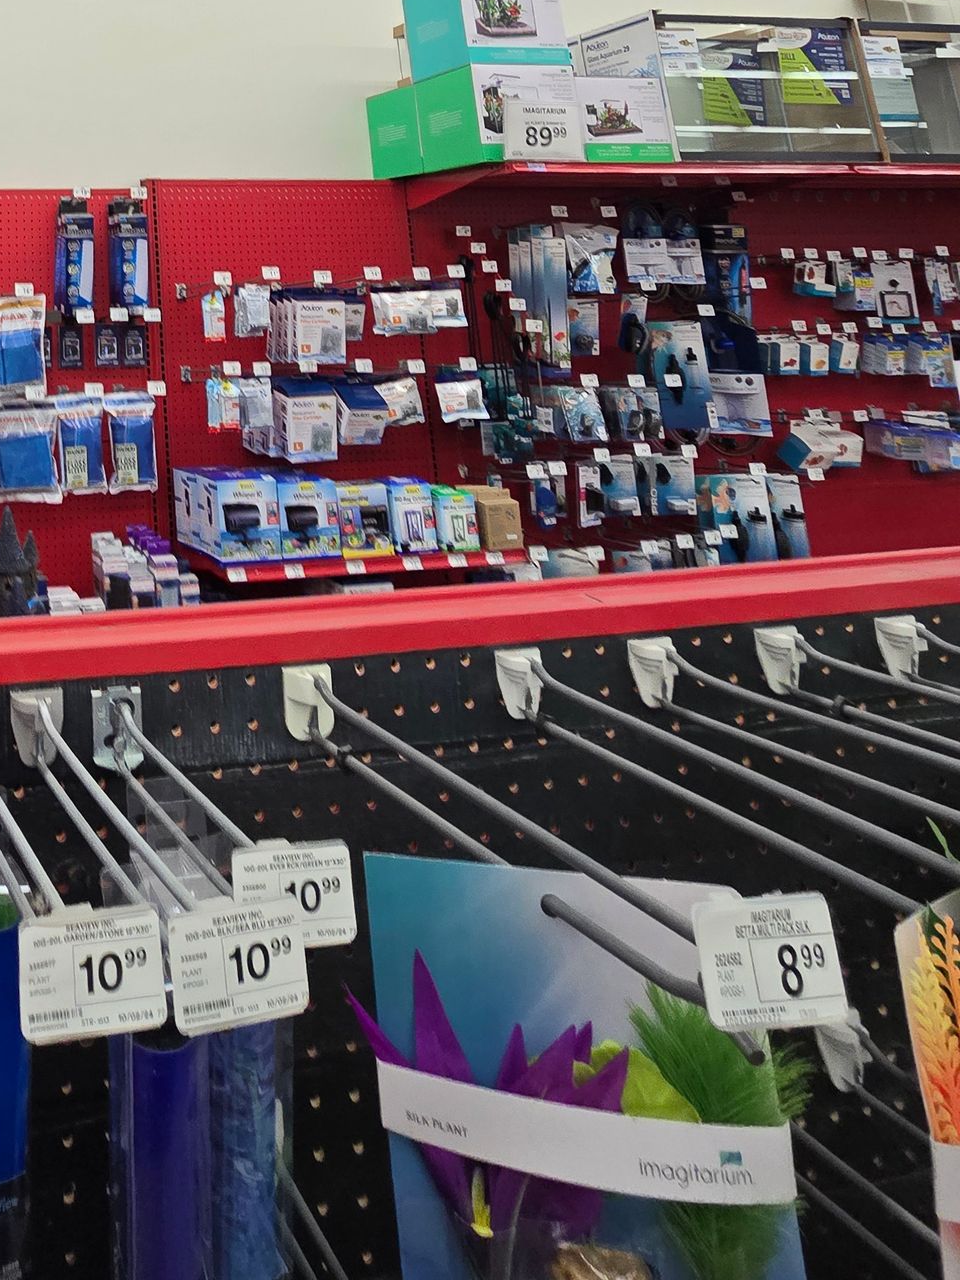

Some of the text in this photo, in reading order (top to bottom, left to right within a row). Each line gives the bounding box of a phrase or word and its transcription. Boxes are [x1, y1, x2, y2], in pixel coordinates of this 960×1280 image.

[522, 107, 567, 115] IMAGITARIUM
[735, 924, 757, 939] BETTA
[431, 1117, 469, 1138] PLANT
[638, 1158, 754, 1190] imagitarium
